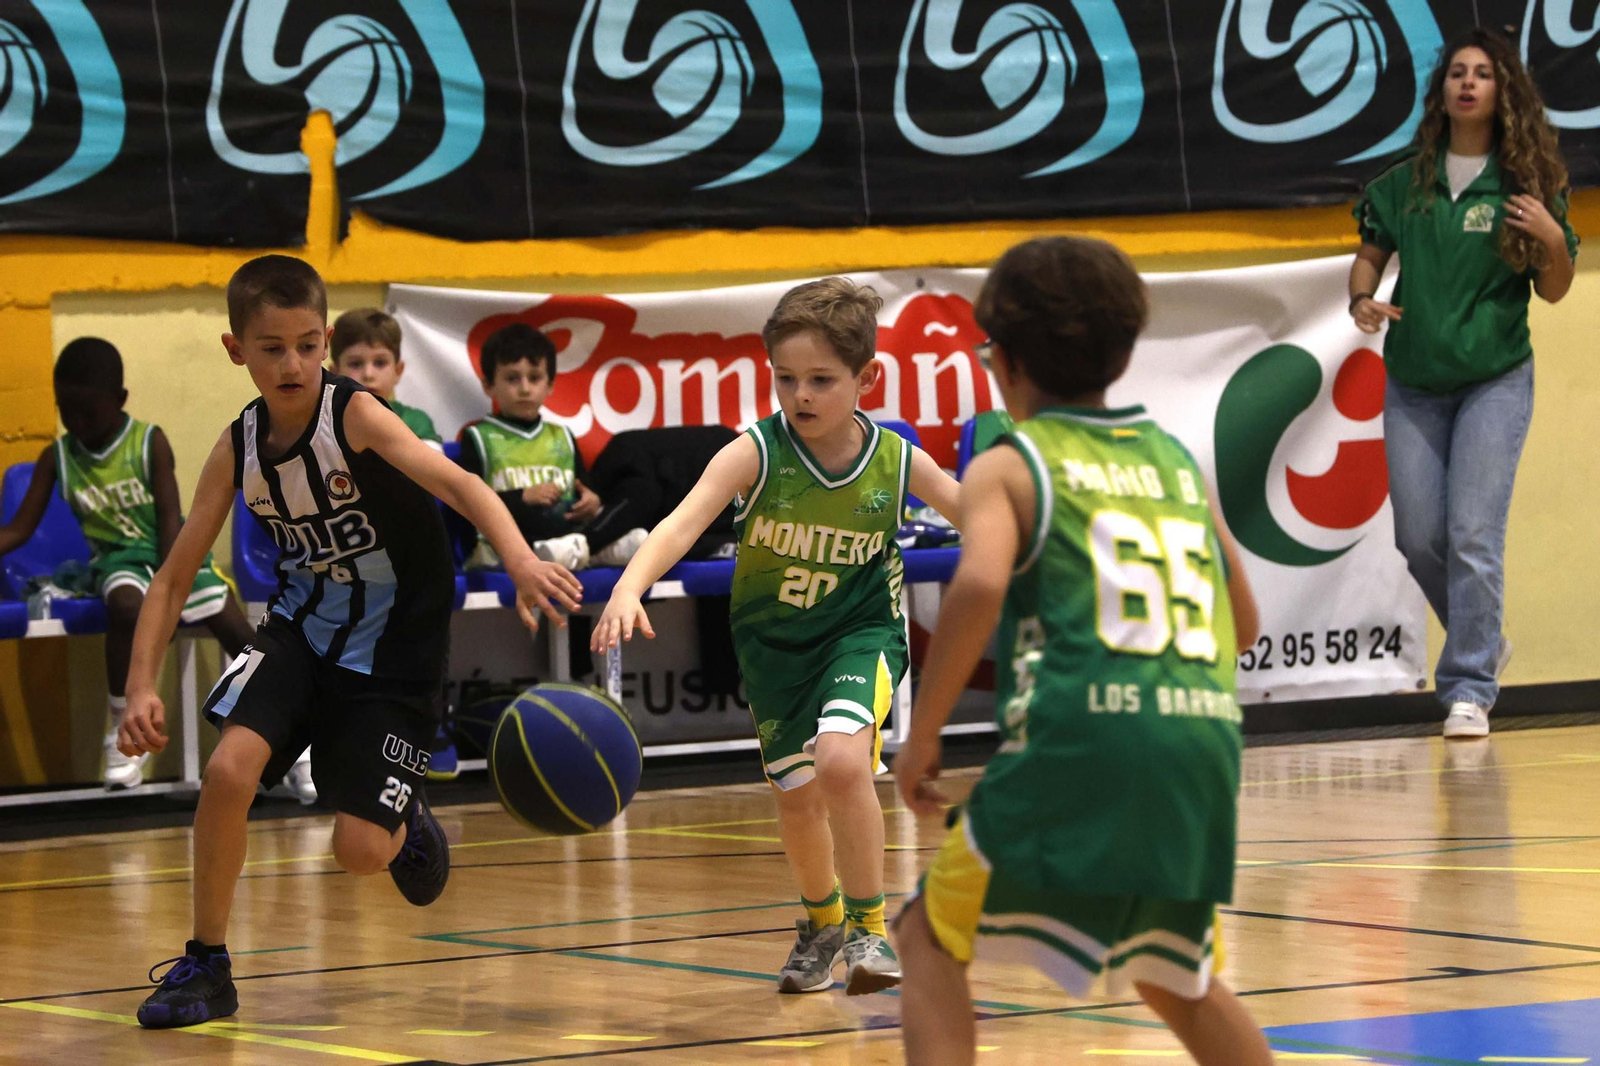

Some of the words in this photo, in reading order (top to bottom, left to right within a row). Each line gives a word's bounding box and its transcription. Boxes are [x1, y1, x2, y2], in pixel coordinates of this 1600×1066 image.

[266, 509, 377, 567] ULB
[778, 565, 839, 610] 20
[1088, 508, 1218, 663] 65
[1282, 632, 1315, 667] 95
[1325, 628, 1358, 664] 58
[1369, 625, 1402, 660] 24
[834, 673, 867, 684] vive
[1088, 683, 1141, 713] LOS
[382, 733, 432, 776] ULB
[379, 776, 412, 814] 26
